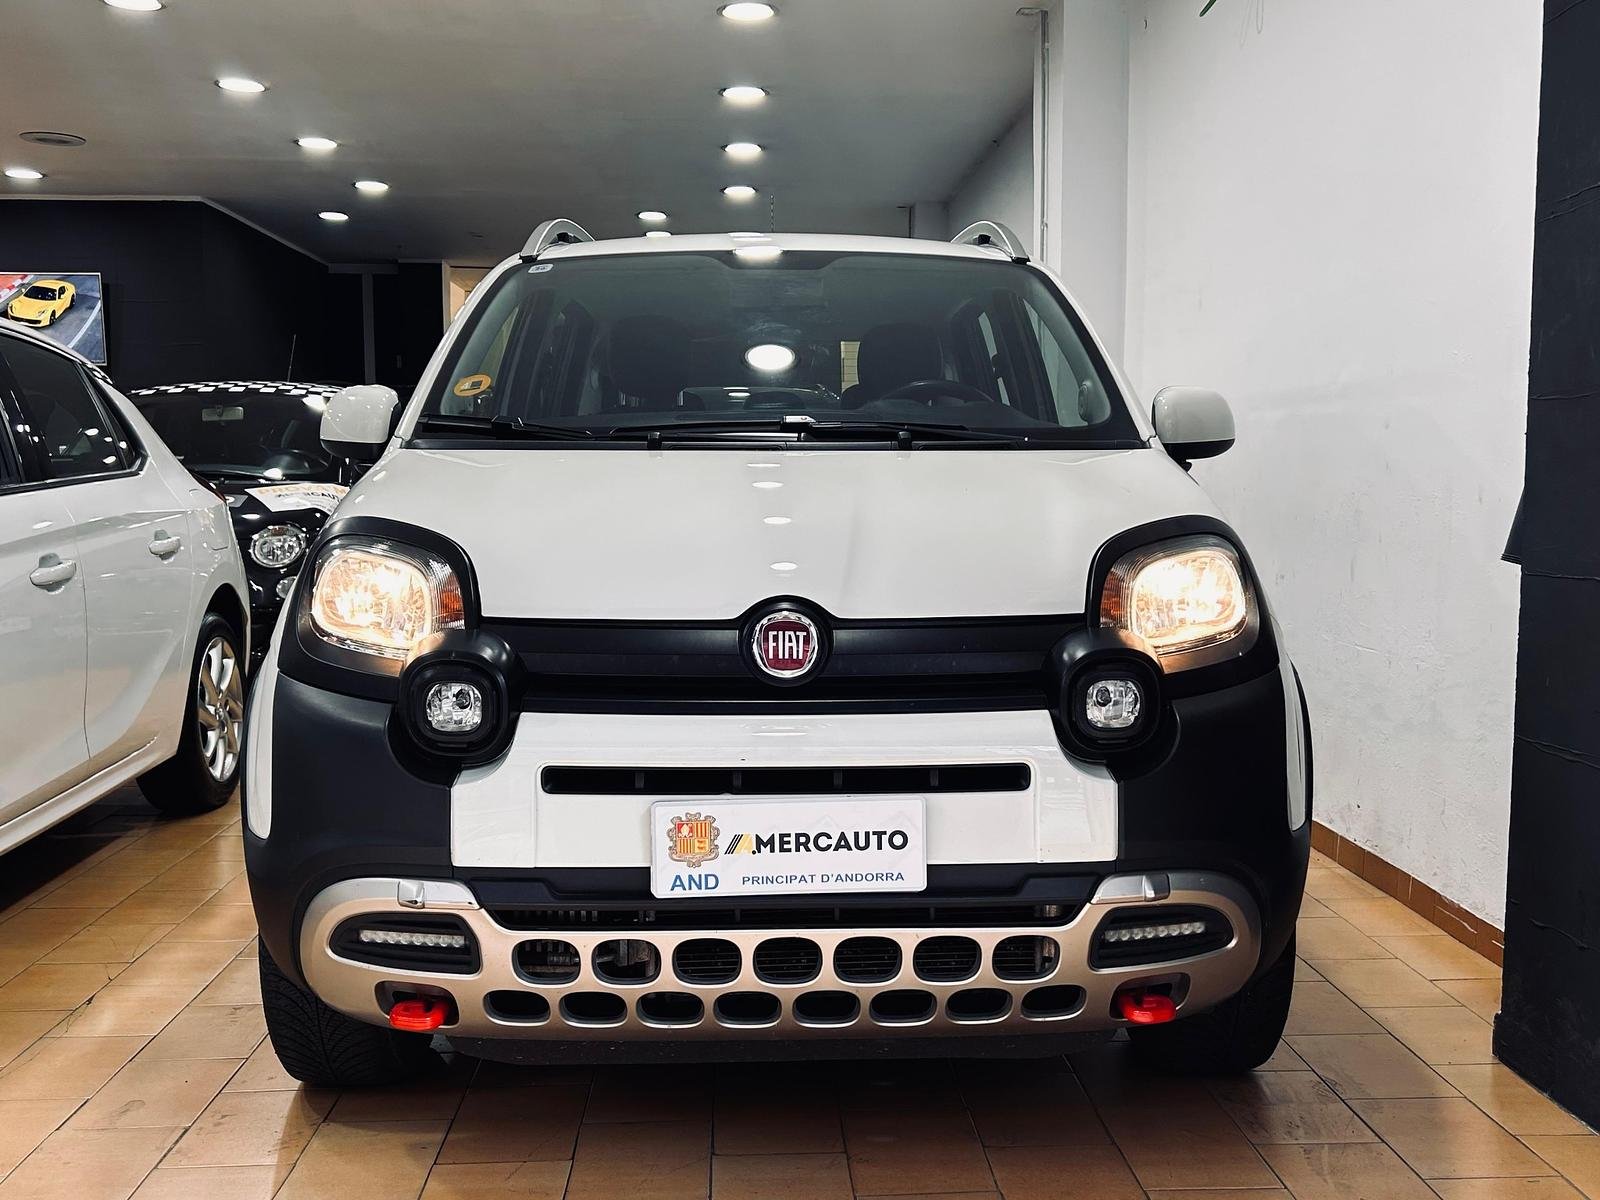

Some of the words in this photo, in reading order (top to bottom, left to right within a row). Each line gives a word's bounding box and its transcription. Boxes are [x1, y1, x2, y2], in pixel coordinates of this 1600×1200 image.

[768, 630, 807, 660] FIAT
[670, 873, 720, 891] AND
[742, 873, 816, 885] PRINCIPAT
[821, 872, 905, 884] D'ANDORRA
